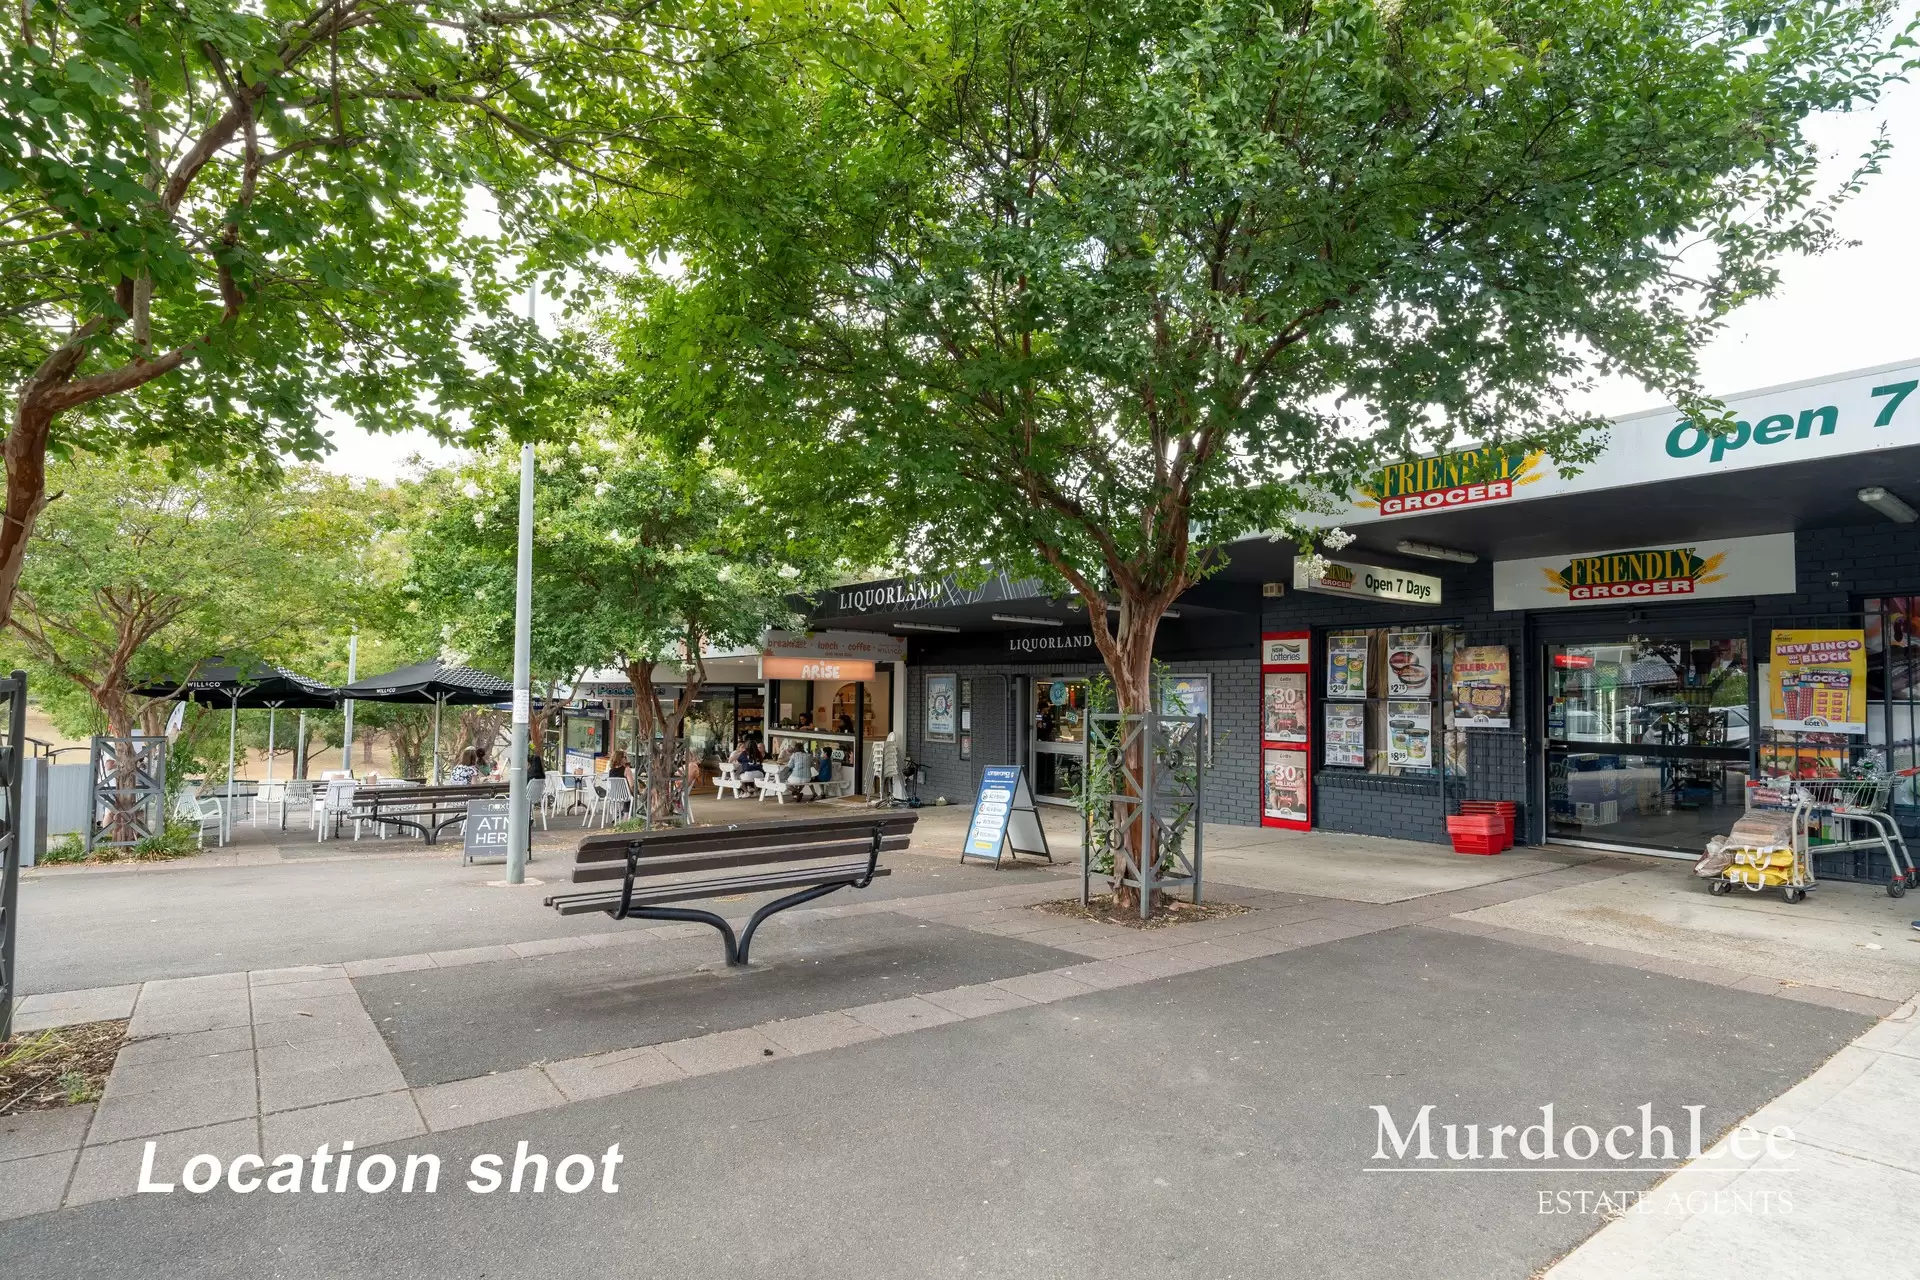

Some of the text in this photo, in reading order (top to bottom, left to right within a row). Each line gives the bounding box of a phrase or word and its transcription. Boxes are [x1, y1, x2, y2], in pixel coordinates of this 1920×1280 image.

[1665, 379, 1920, 463] Open 7
[1384, 482, 1509, 513] GROCER
[1570, 548, 1696, 586] FRIENDLY
[1321, 579, 1352, 589] GROCER
[1365, 574, 1431, 599] Open 7 Days
[1572, 580, 1692, 599] GROCER
[840, 580, 941, 612] LIQUORLAND
[818, 641, 839, 650] lunch
[847, 641, 872, 652] coffee
[1010, 635, 1093, 653] LIQUORLAND
[1776, 639, 1860, 655] NEW BINGO
[1270, 652, 1301, 662] Lotteries
[1801, 652, 1849, 663] BLOCK
[1454, 662, 1506, 673] CELEBRATE
